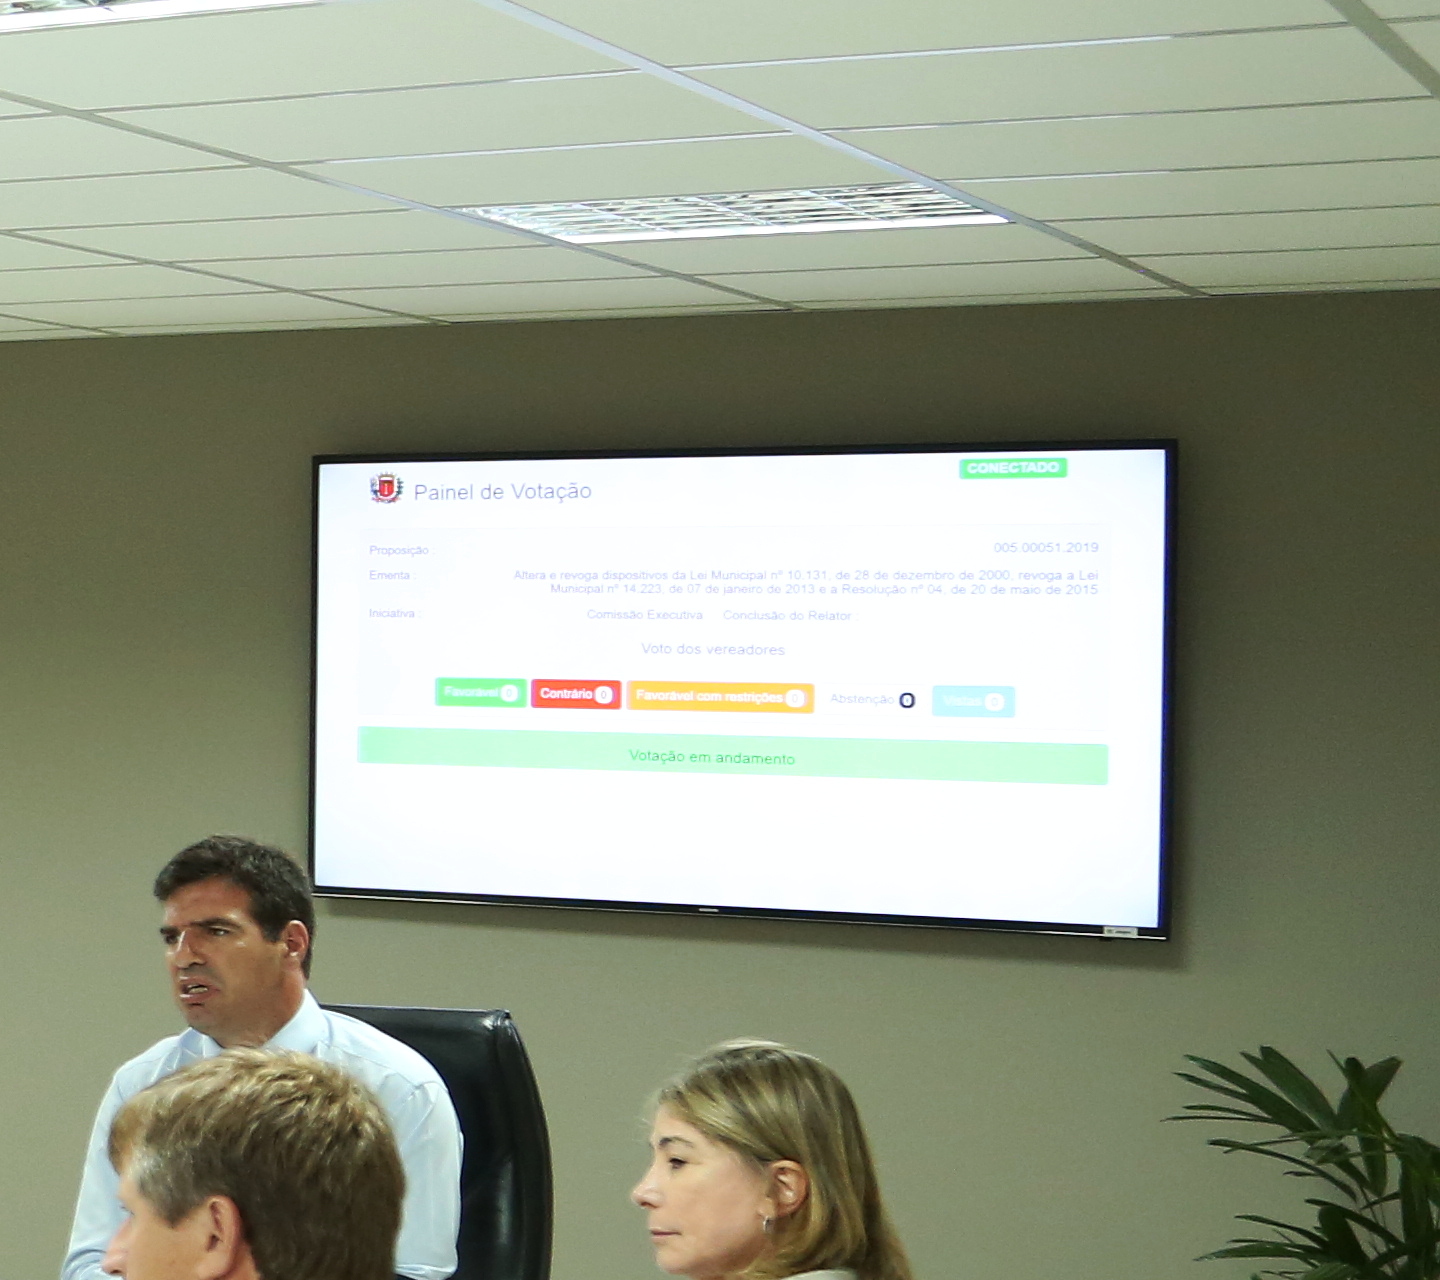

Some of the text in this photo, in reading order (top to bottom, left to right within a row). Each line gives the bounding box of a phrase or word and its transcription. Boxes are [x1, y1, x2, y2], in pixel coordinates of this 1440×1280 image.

[966, 460, 1061, 475] CONECTADO
[414, 482, 592, 504] Painel de Votação
[369, 545, 430, 558] Proposição
[369, 570, 410, 580] Ementa
[602, 571, 668, 582] dispositivos
[711, 571, 767, 582] Municipal
[550, 584, 604, 595] Municipal
[587, 609, 704, 620] Comissão Executiva
[723, 609, 785, 621] Conclusão
[641, 643, 786, 656] Voto dos vereadores
[540, 687, 593, 700] Contrário
[635, 689, 694, 702] Favorável
[696, 692, 723, 702] com
[725, 691, 784, 705] restrições
[629, 748, 796, 766] Votação em andamento
